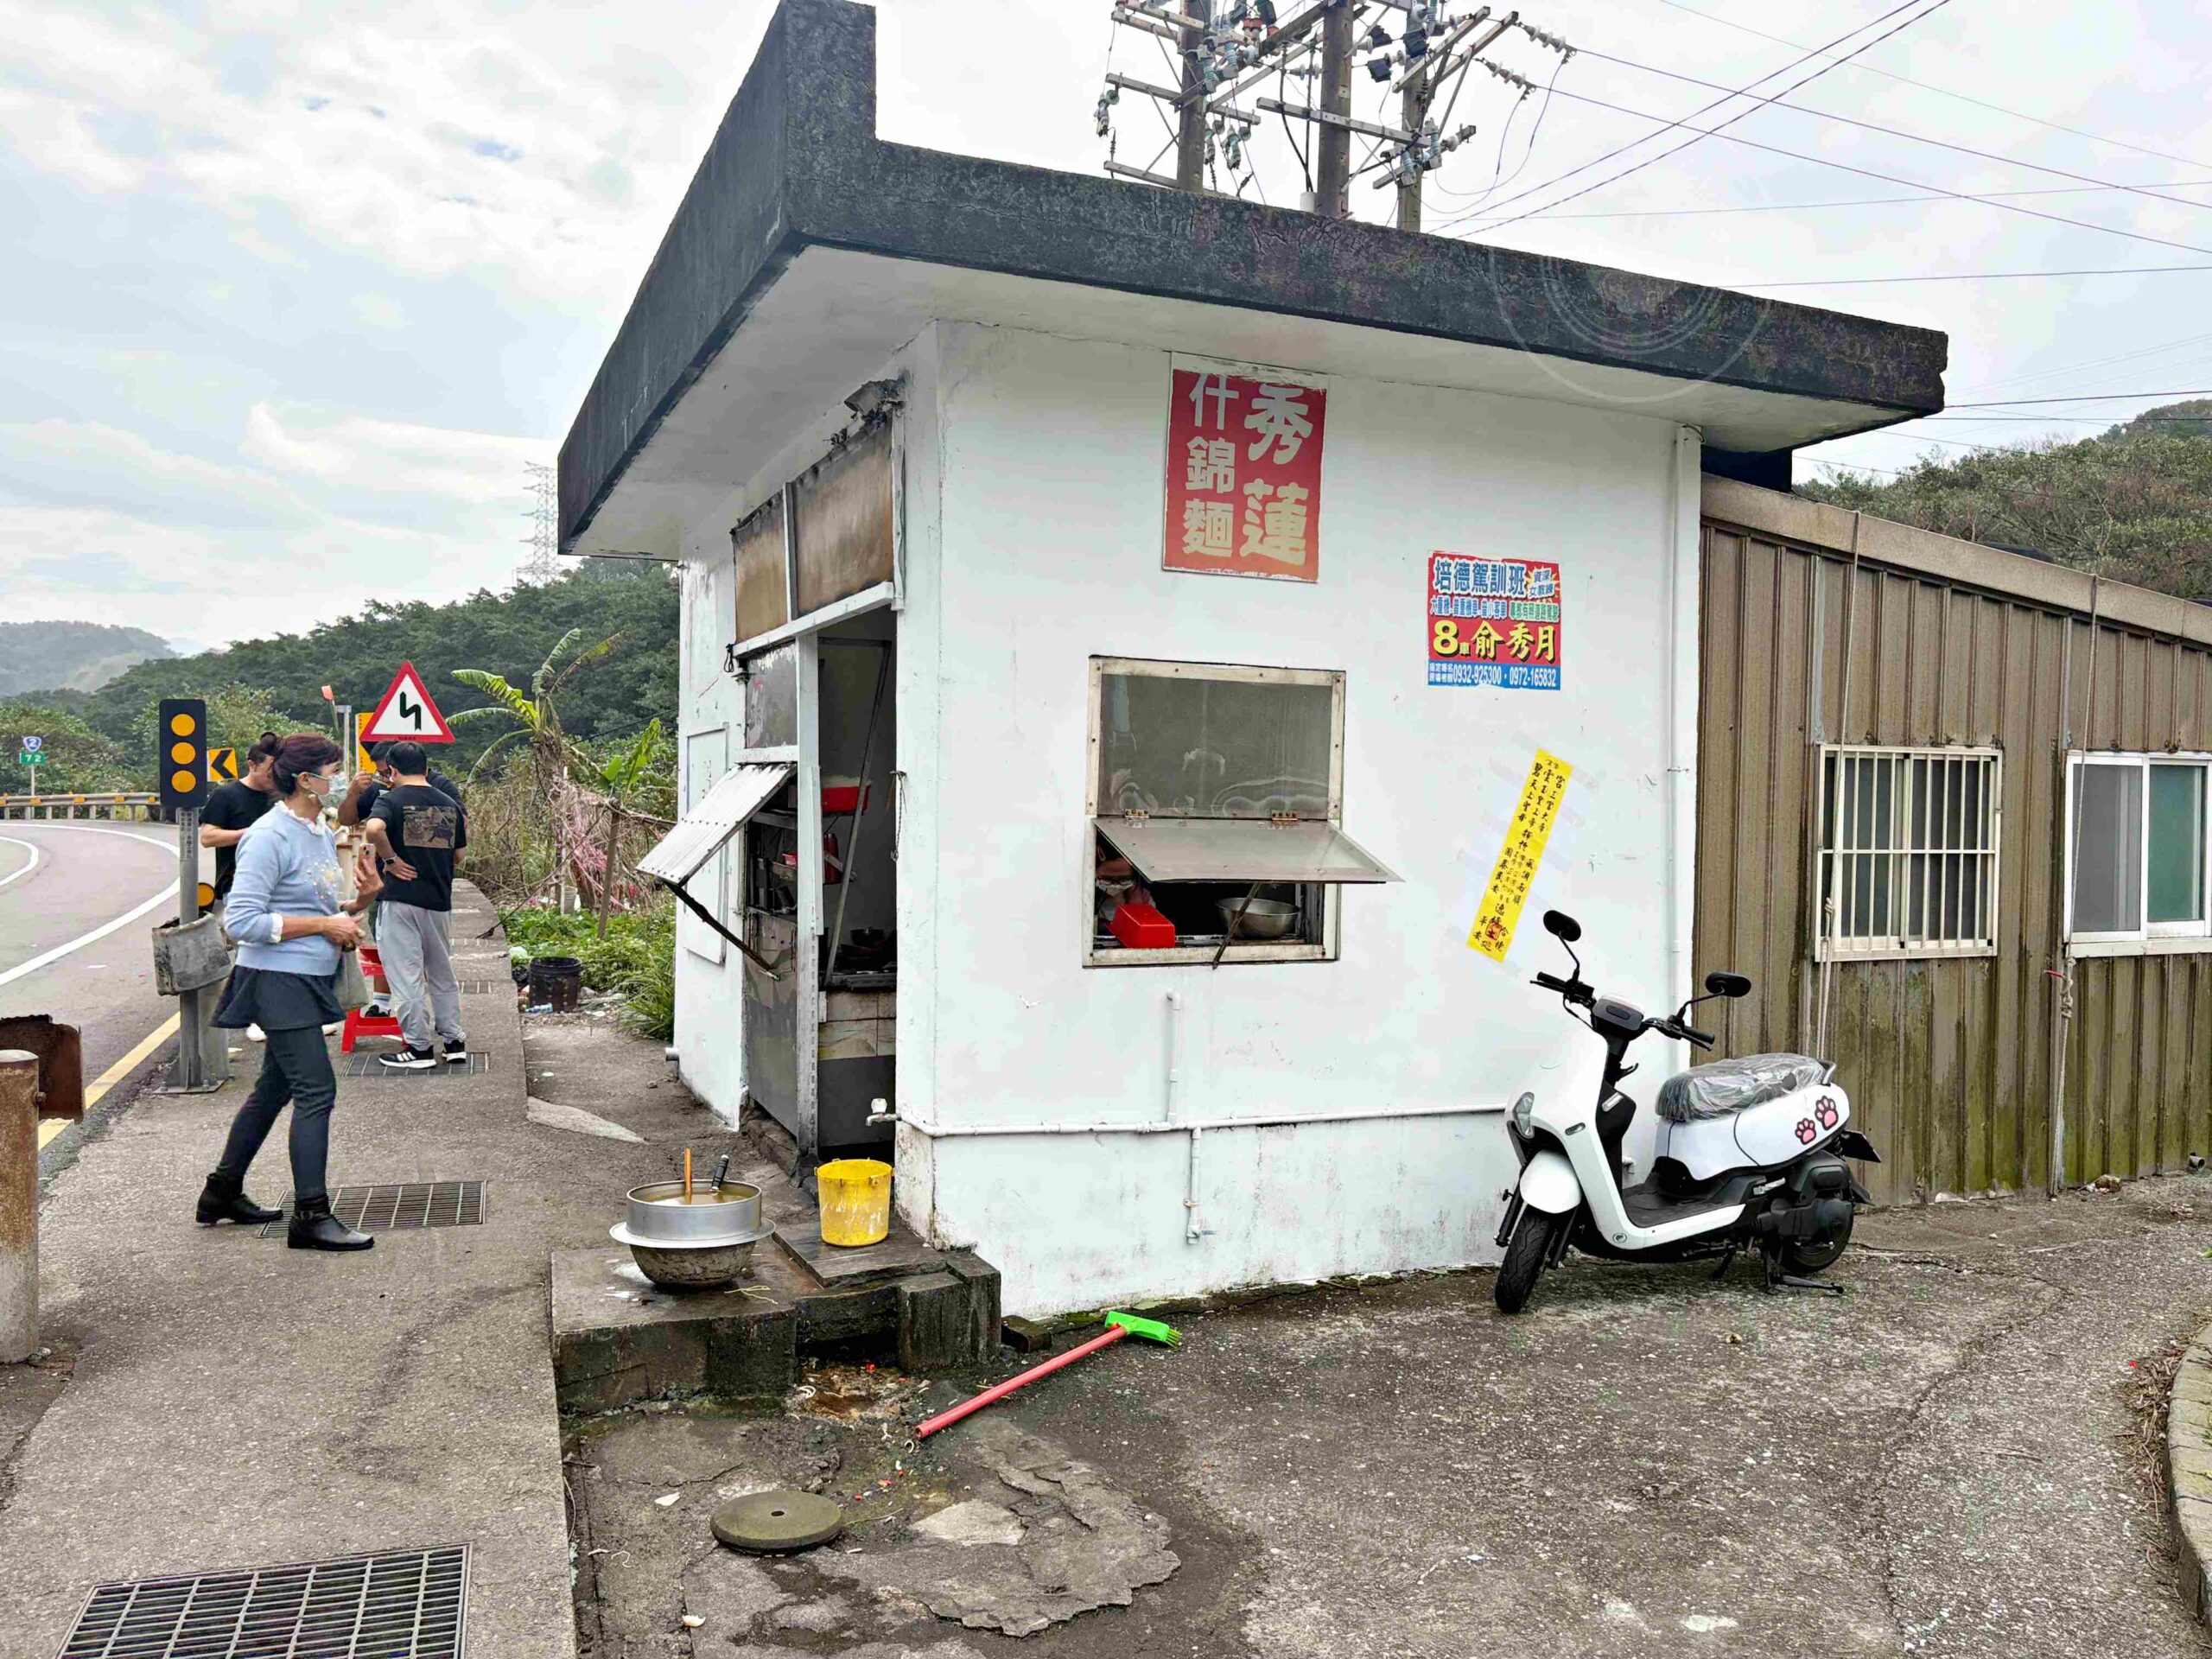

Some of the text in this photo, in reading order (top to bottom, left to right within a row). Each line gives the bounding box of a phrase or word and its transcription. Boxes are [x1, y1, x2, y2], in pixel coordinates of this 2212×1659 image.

[1182, 372, 1239, 557] 什錦麵
[1239, 383, 1313, 565] 秀蓮
[1434, 559, 1526, 595] 培德駕訓班
[1471, 620, 1555, 661] 俞秀月
[1452, 664, 1502, 684] 0932-925300
[1510, 666, 1556, 687] 0972-165832
[29, 738, 37, 747] 2
